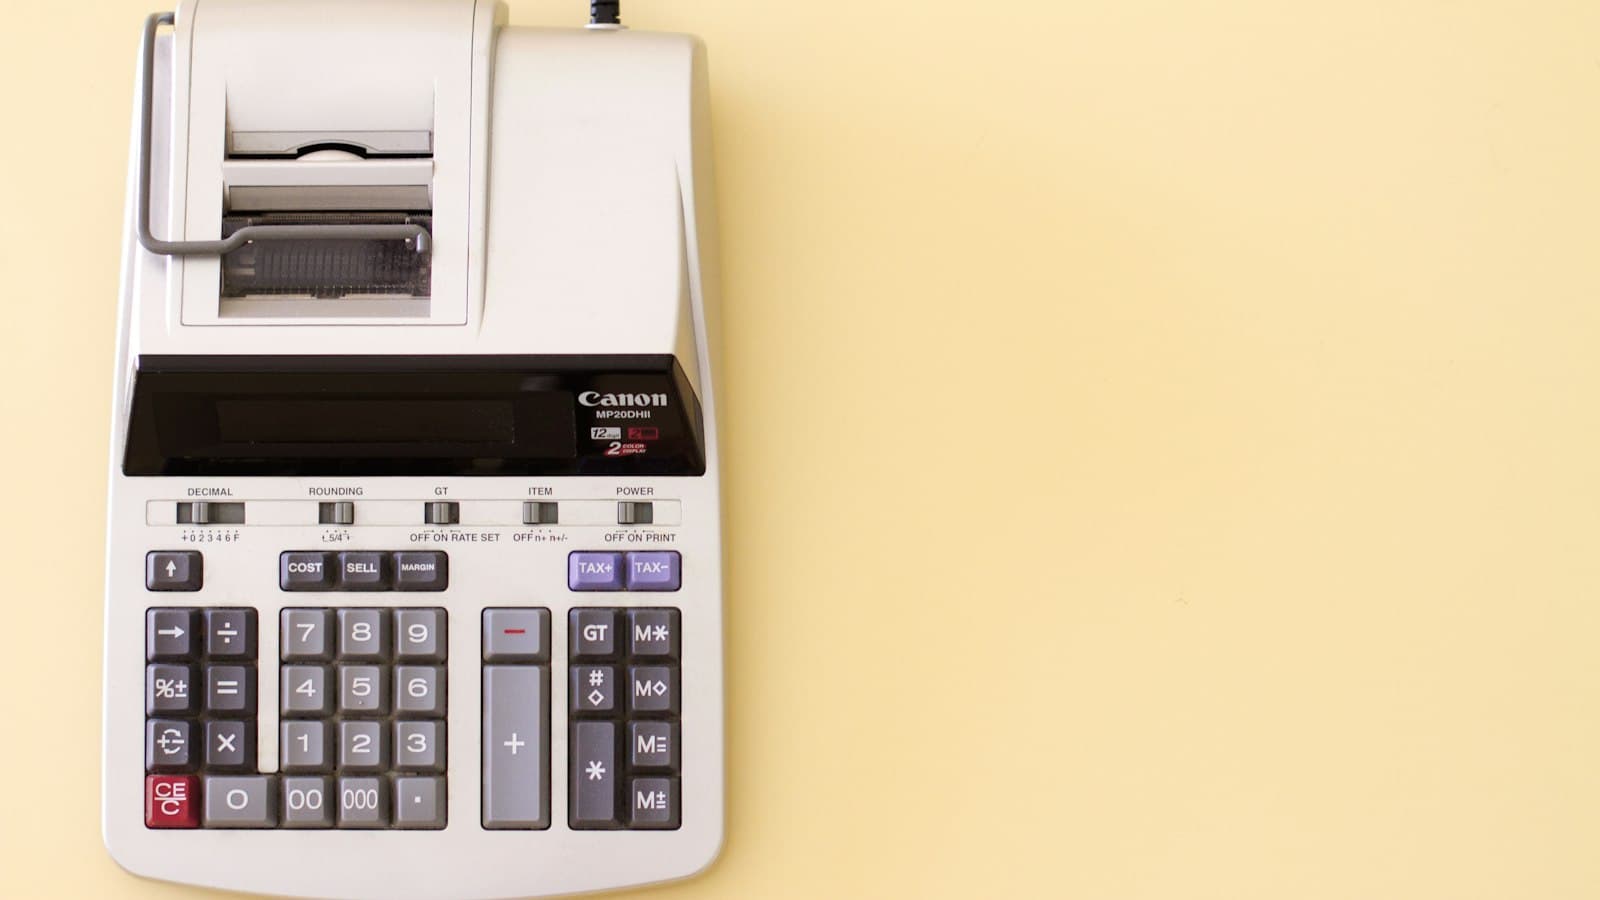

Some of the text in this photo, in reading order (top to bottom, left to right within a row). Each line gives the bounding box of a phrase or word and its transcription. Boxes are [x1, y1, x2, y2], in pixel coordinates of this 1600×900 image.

[578, 391, 667, 407] Canon
[596, 410, 651, 419] MP20DHII
[592, 428, 607, 438] 12
[607, 441, 622, 455] 2
[187, 487, 233, 496] DECIMAL
[309, 487, 363, 496] ROUNDING
[434, 487, 448, 496] GT
[528, 487, 553, 496] ITEM
[616, 487, 654, 496] POWER
[410, 533, 500, 542] OFF ON RATE SET
[513, 533, 533, 542] OFF
[604, 533, 676, 542] OFF ON PRINT
[288, 562, 323, 574] COST
[346, 562, 378, 574] SELL
[401, 563, 435, 572] MARGIN
[578, 562, 613, 574] TAX+
[634, 562, 669, 574] TAX-
[296, 623, 316, 642] 7
[351, 622, 372, 642] 8
[407, 624, 428, 643] 9
[583, 624, 608, 641] GT
[295, 679, 316, 697] 4
[351, 677, 371, 696] 5
[407, 678, 428, 697] 6
[297, 734, 309, 752] 1
[351, 734, 371, 753] 2
[407, 733, 427, 752] 3
[155, 782, 186, 797] CE
[226, 789, 249, 810] 0
[288, 789, 323, 810] 00
[343, 789, 378, 810] 000
[160, 800, 180, 815] C
